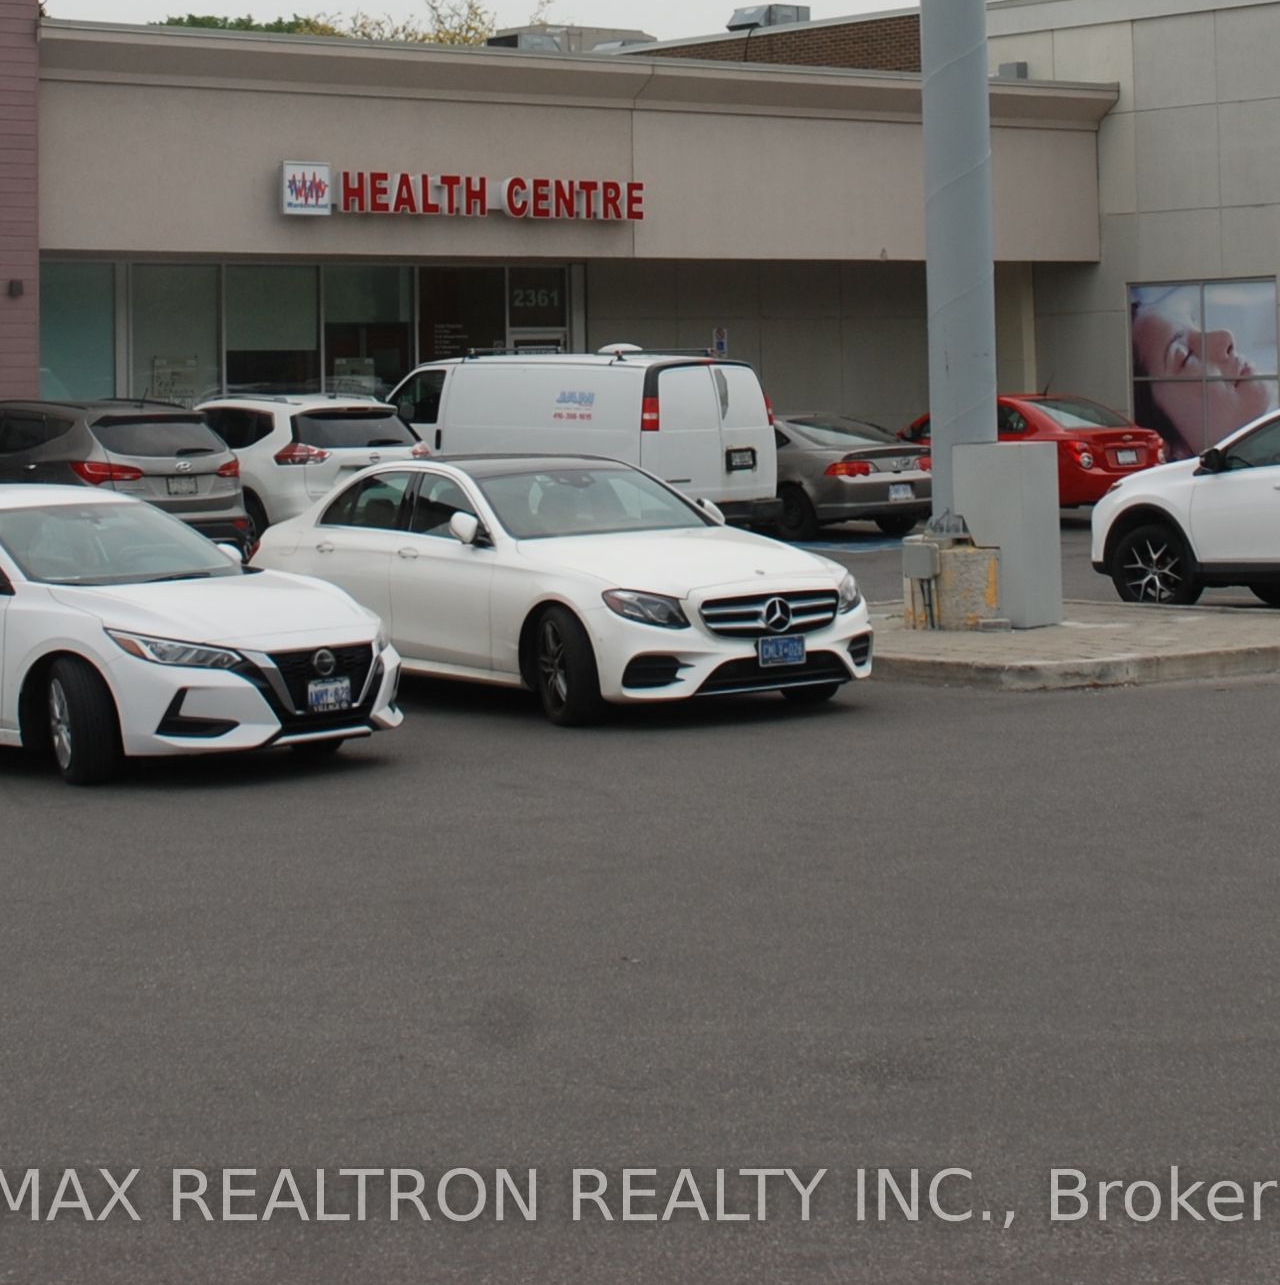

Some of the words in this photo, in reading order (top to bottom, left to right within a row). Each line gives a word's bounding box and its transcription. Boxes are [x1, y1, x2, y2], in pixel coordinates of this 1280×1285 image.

[341, 171, 487, 215] HEALTH
[506, 176, 645, 220] CENTRE
[513, 289, 559, 307] 2361
